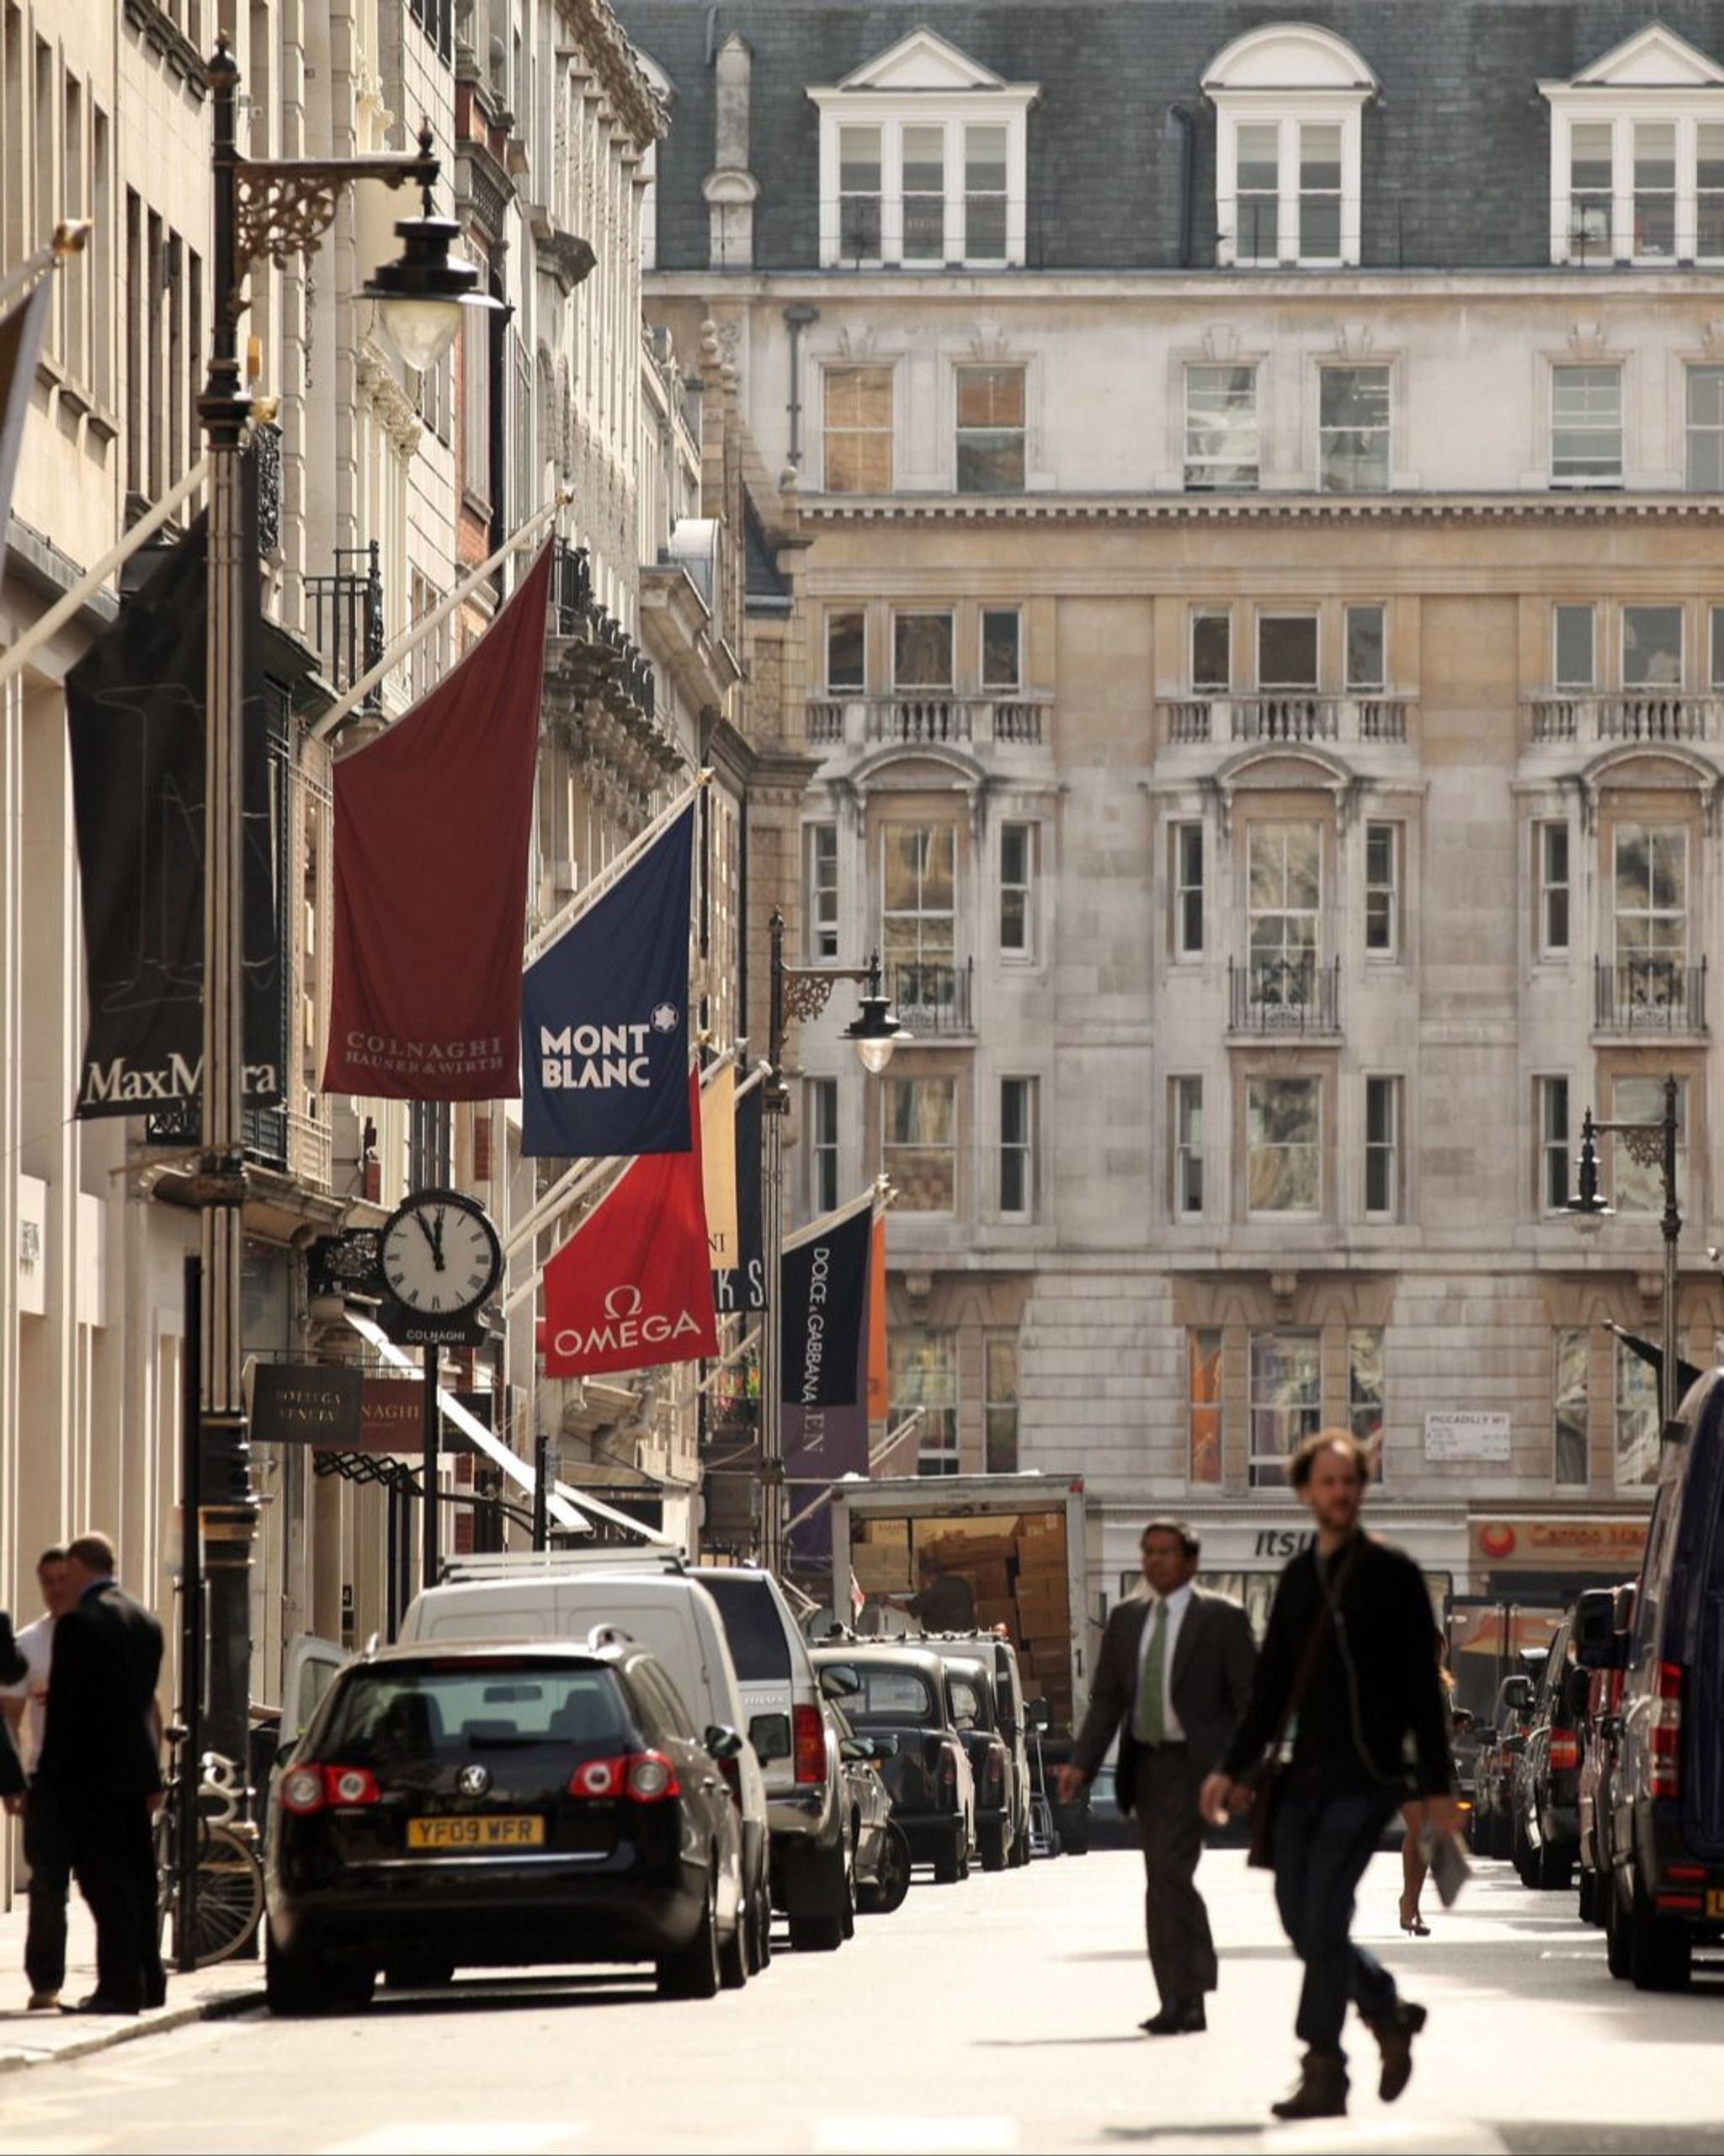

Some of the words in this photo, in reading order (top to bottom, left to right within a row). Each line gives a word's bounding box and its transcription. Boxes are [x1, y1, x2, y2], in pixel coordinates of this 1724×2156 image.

[346, 1030, 502, 1060] COLNAGHI
[541, 1025, 650, 1056] MONT
[82, 1052, 277, 1105] MaxMra
[542, 1057, 651, 1089] BLANC
[406, 1329, 466, 1342] COLNAGHI
[554, 1309, 702, 1357] OMEGA
[418, 1820, 481, 1843] YF09
[487, 1819, 533, 1842] WFR
